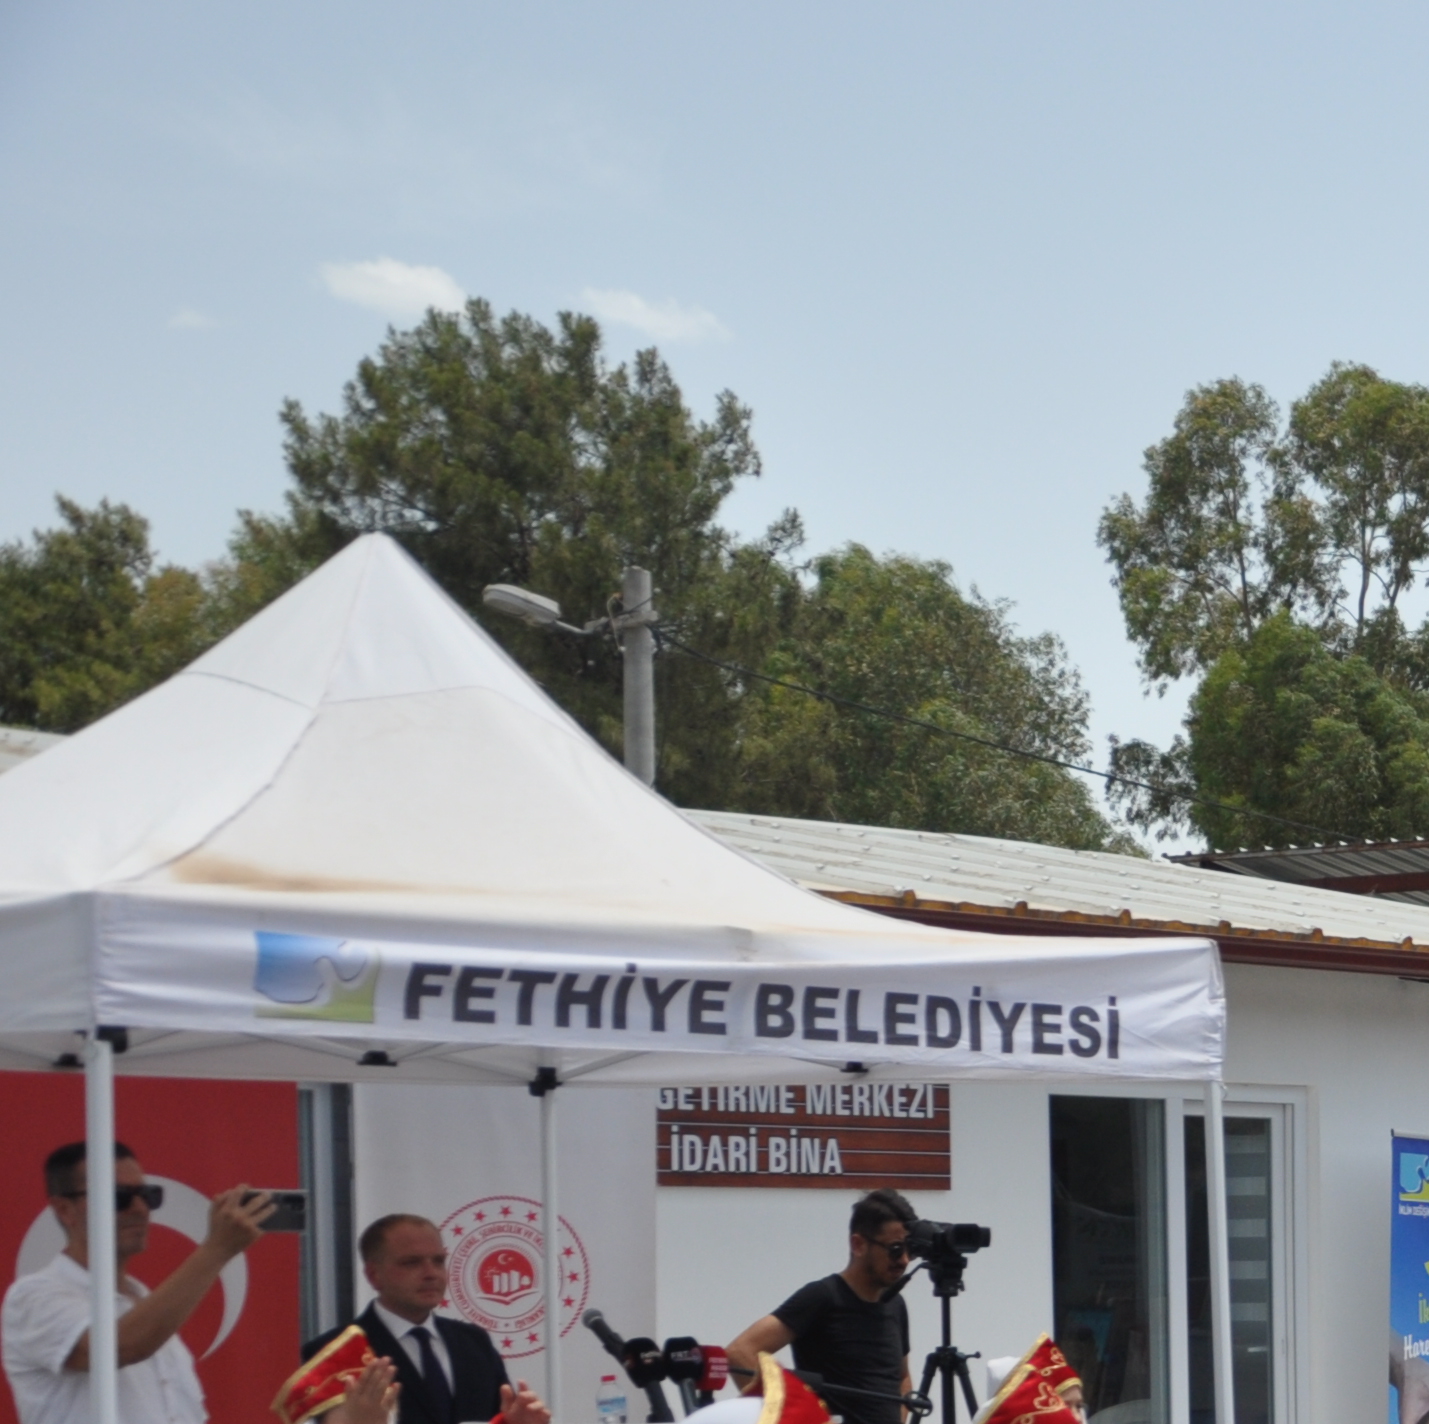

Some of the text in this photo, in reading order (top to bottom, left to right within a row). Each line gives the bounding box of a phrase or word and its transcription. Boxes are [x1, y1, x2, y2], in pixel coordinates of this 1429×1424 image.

[404, 963, 1121, 1060] FETHİYE BELEDİYESİ
[670, 1125, 842, 1175] İDARİ BİNA
